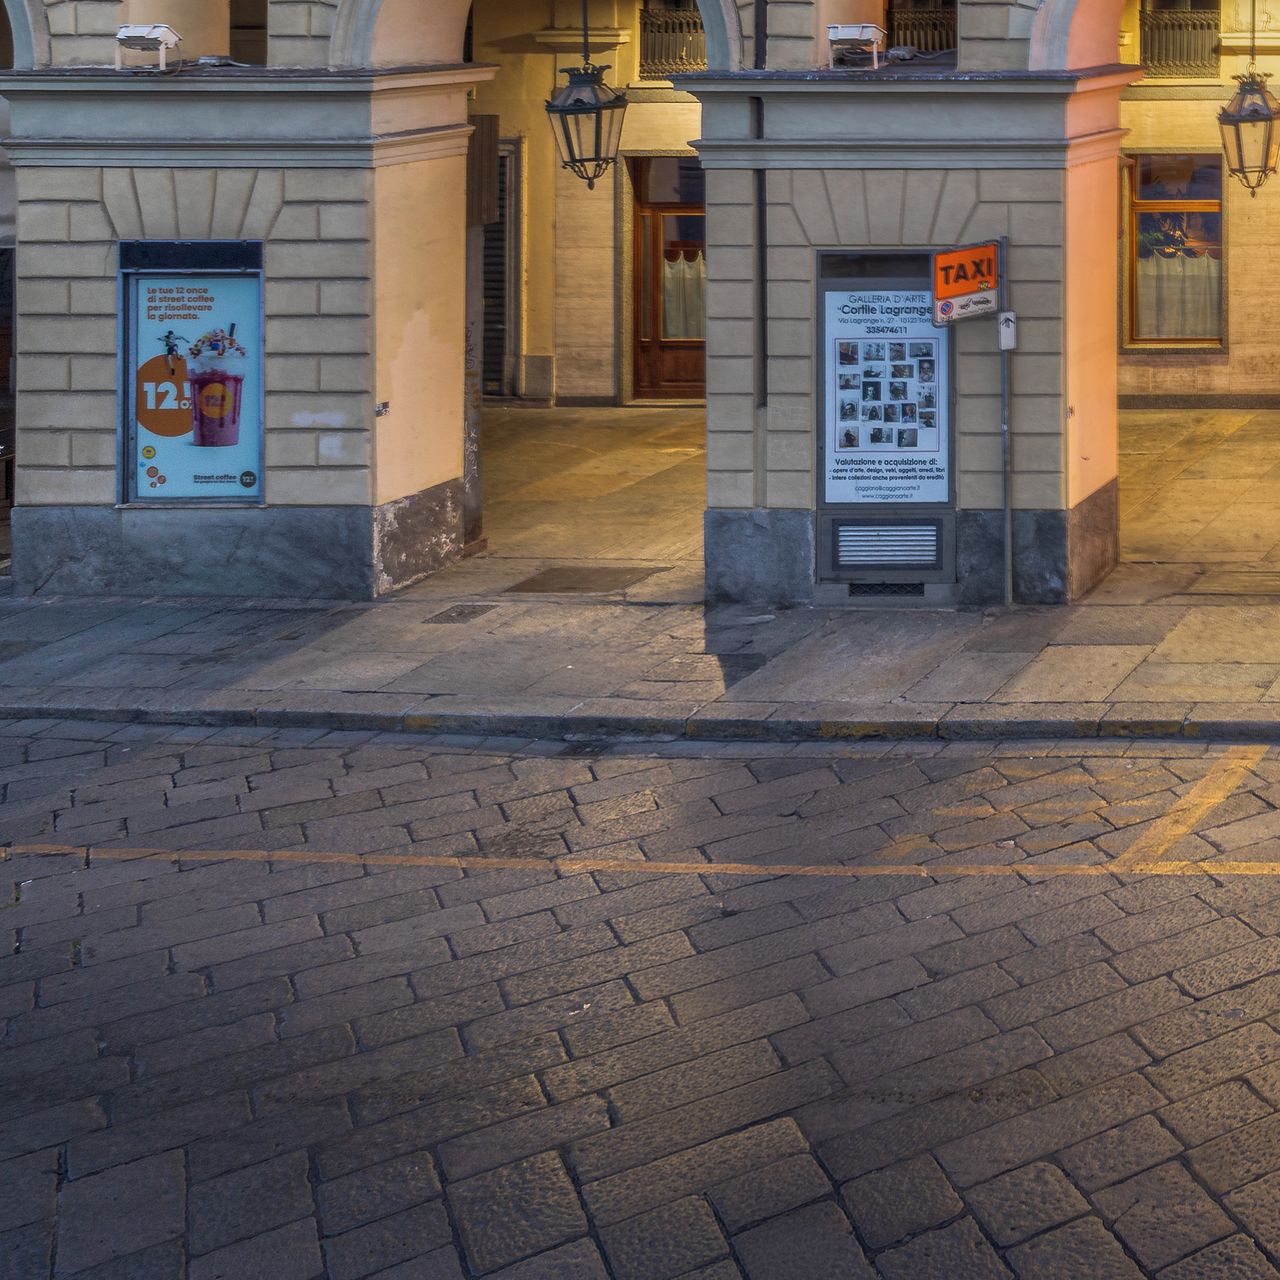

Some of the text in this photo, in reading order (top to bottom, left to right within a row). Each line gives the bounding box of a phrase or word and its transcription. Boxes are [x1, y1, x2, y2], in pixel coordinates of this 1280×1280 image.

[940, 257, 992, 286] TAXI
[147, 295, 157, 303] di
[187, 295, 215, 303] coffee
[848, 295, 927, 304] GALLERIA D'ARTE
[147, 305, 162, 313] per
[835, 458, 876, 466] Valutazione
[884, 458, 927, 467] acquisizione
